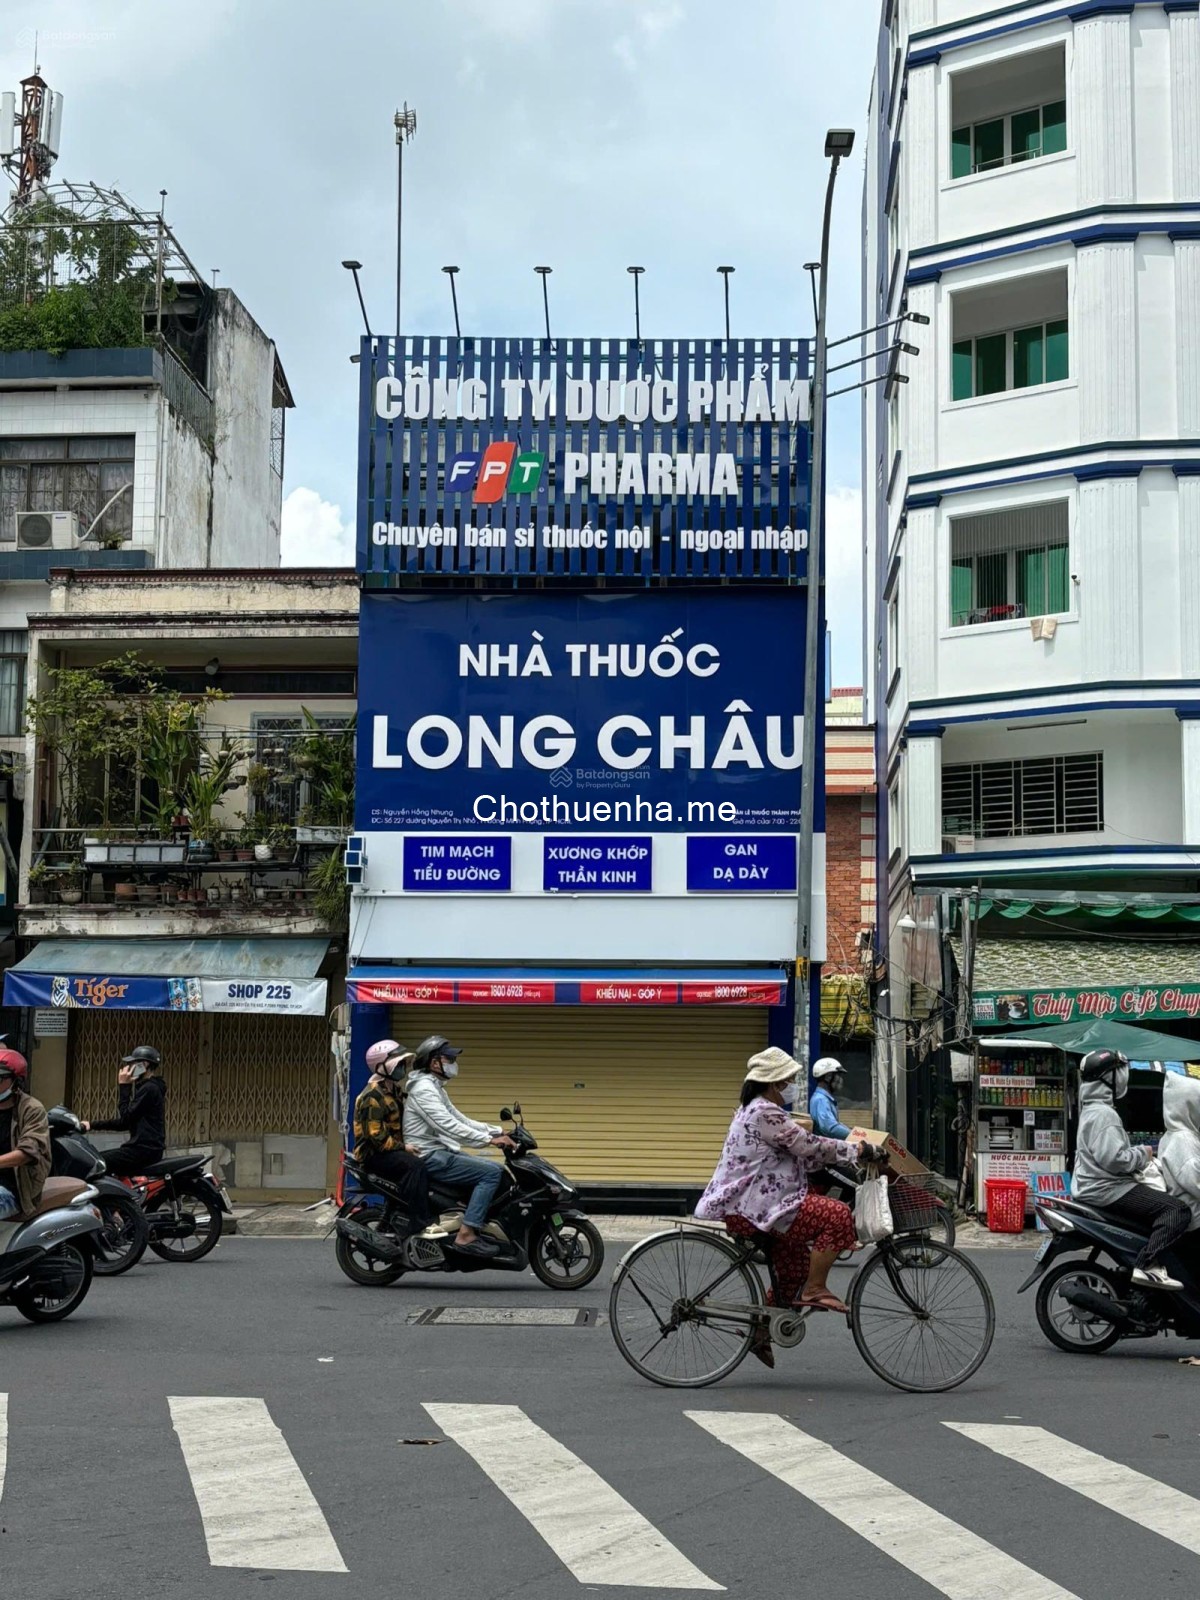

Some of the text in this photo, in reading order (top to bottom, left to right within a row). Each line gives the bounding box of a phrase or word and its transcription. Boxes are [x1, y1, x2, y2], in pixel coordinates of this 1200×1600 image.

[376, 363, 810, 430] CÔNG TY DƯỢC PHẨM
[564, 452, 740, 495] PHARMA
[372, 521, 457, 549] Chuyên
[464, 523, 507, 548] bán
[514, 521, 535, 548] sỉ
[542, 520, 608, 549] thuốc
[615, 524, 651, 553] nội
[680, 526, 744, 553] ngoại
[751, 526, 808, 554] nhập
[459, 627, 721, 677] NHÀ THUỐC
[372, 699, 805, 770] LONG CHÂU
[431, 809, 454, 817] Nhung
[420, 845, 494, 862] TIM MẠCH
[548, 845, 649, 861] XƯƠNG KHỚP
[724, 844, 758, 857] GAN
[413, 864, 501, 882] TIỂU ĐƯỜNG
[558, 866, 637, 883] THẦN KINH
[713, 863, 769, 882] DẠ DÀY
[74, 977, 129, 1006] Tiger
[228, 984, 292, 1000] SHOP 225
[415, 986, 432, 998] GÓP
[490, 985, 505, 998] 1800
[506, 985, 523, 997] 6928
[596, 984, 617, 999] KHIẾU
[618, 988, 631, 1001] NẠI
[638, 987, 655, 999] GÓP
[1032, 991, 1074, 1021] Thủy
[1077, 991, 1117, 1019] Mộc
